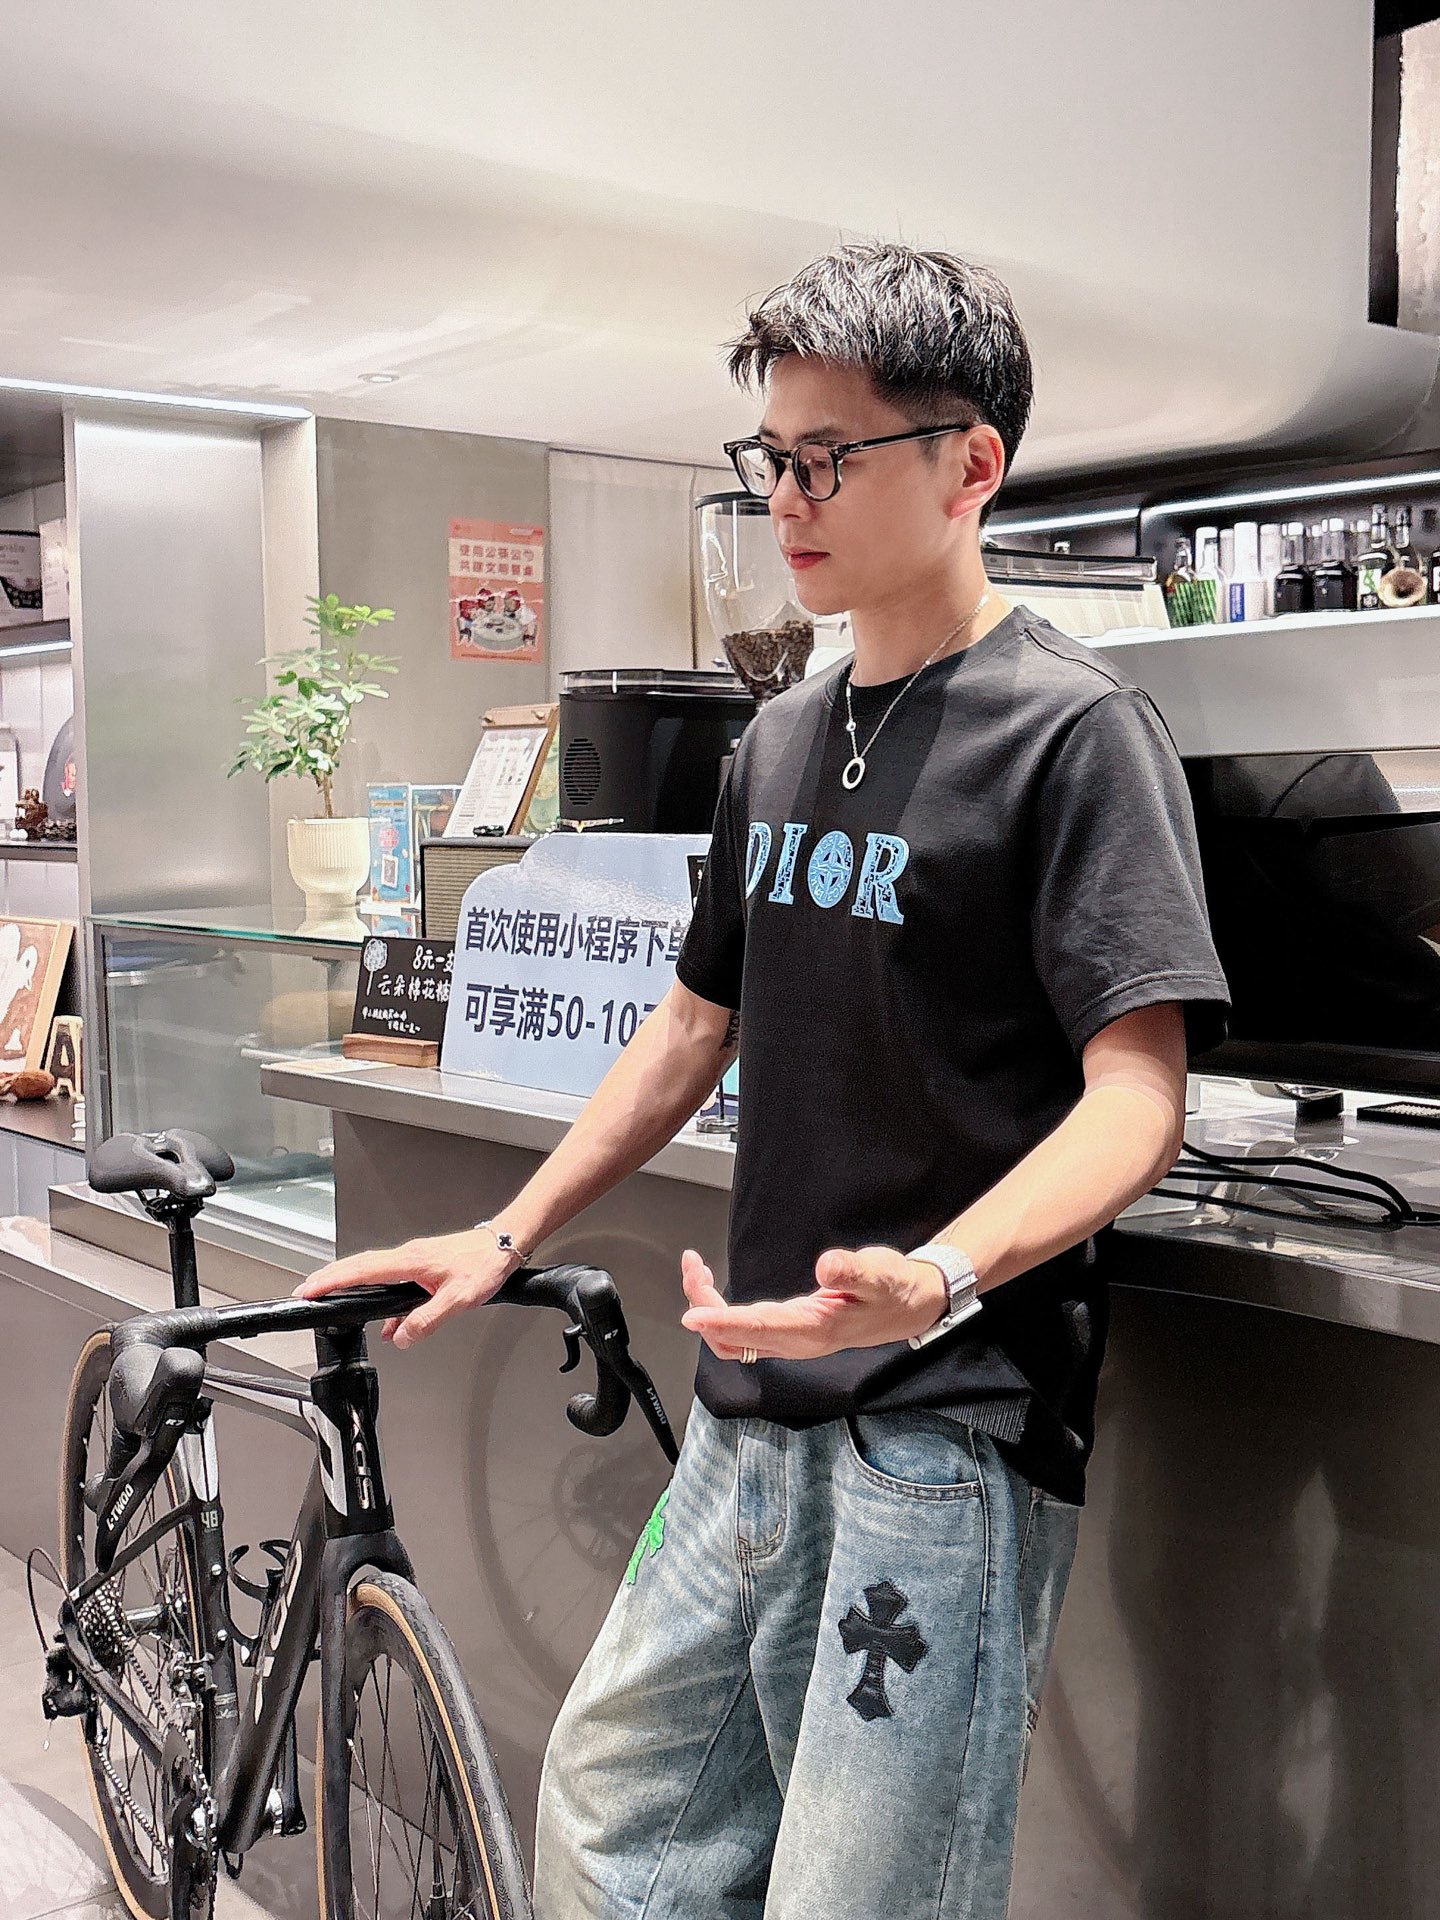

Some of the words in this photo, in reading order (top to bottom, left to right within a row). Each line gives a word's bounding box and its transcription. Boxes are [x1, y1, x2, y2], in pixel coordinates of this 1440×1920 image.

[746, 821, 910, 925] DIOR
[465, 983, 658, 1048] 可享满50-10
[105, 1483, 134, 1531] L-TWOO
